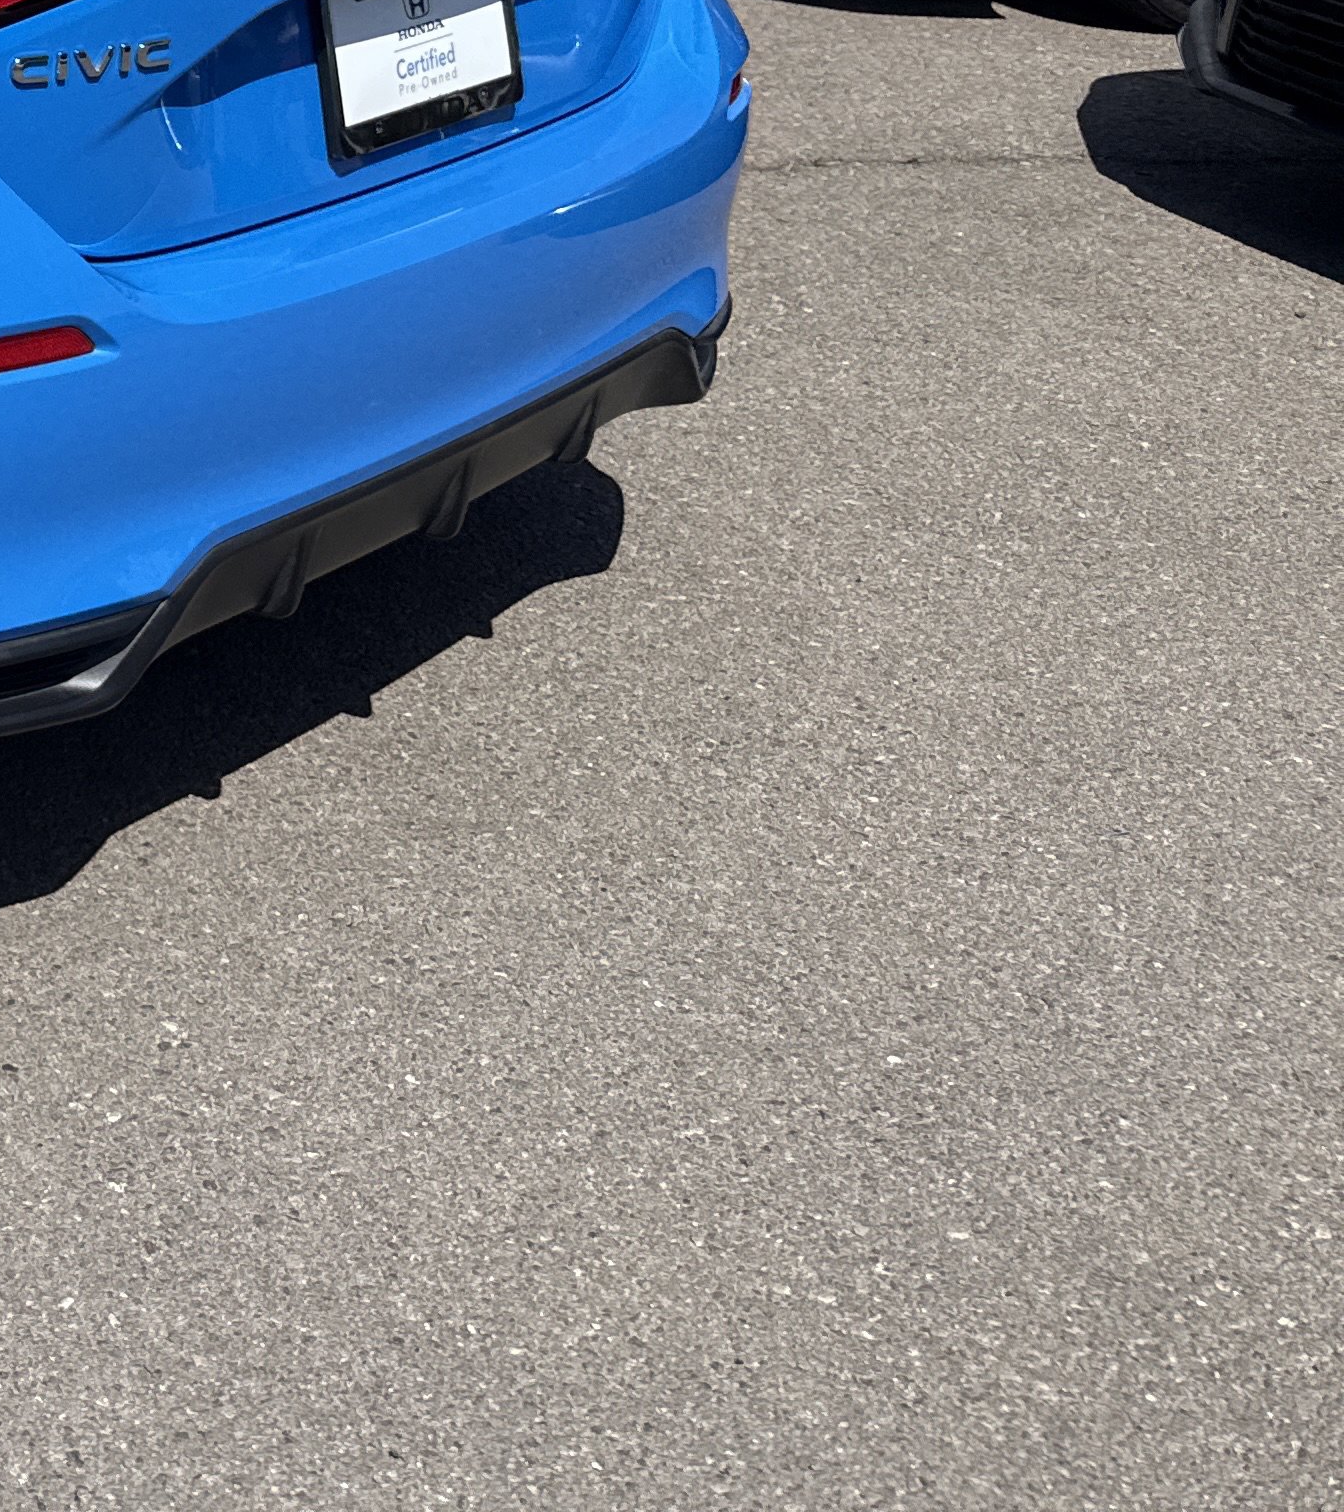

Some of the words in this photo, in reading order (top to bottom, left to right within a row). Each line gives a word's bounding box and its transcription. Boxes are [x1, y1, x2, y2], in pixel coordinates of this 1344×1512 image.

[398, 19, 445, 41] HONDA
[11, 38, 172, 90] CIVIC
[396, 41, 456, 80] Certified
